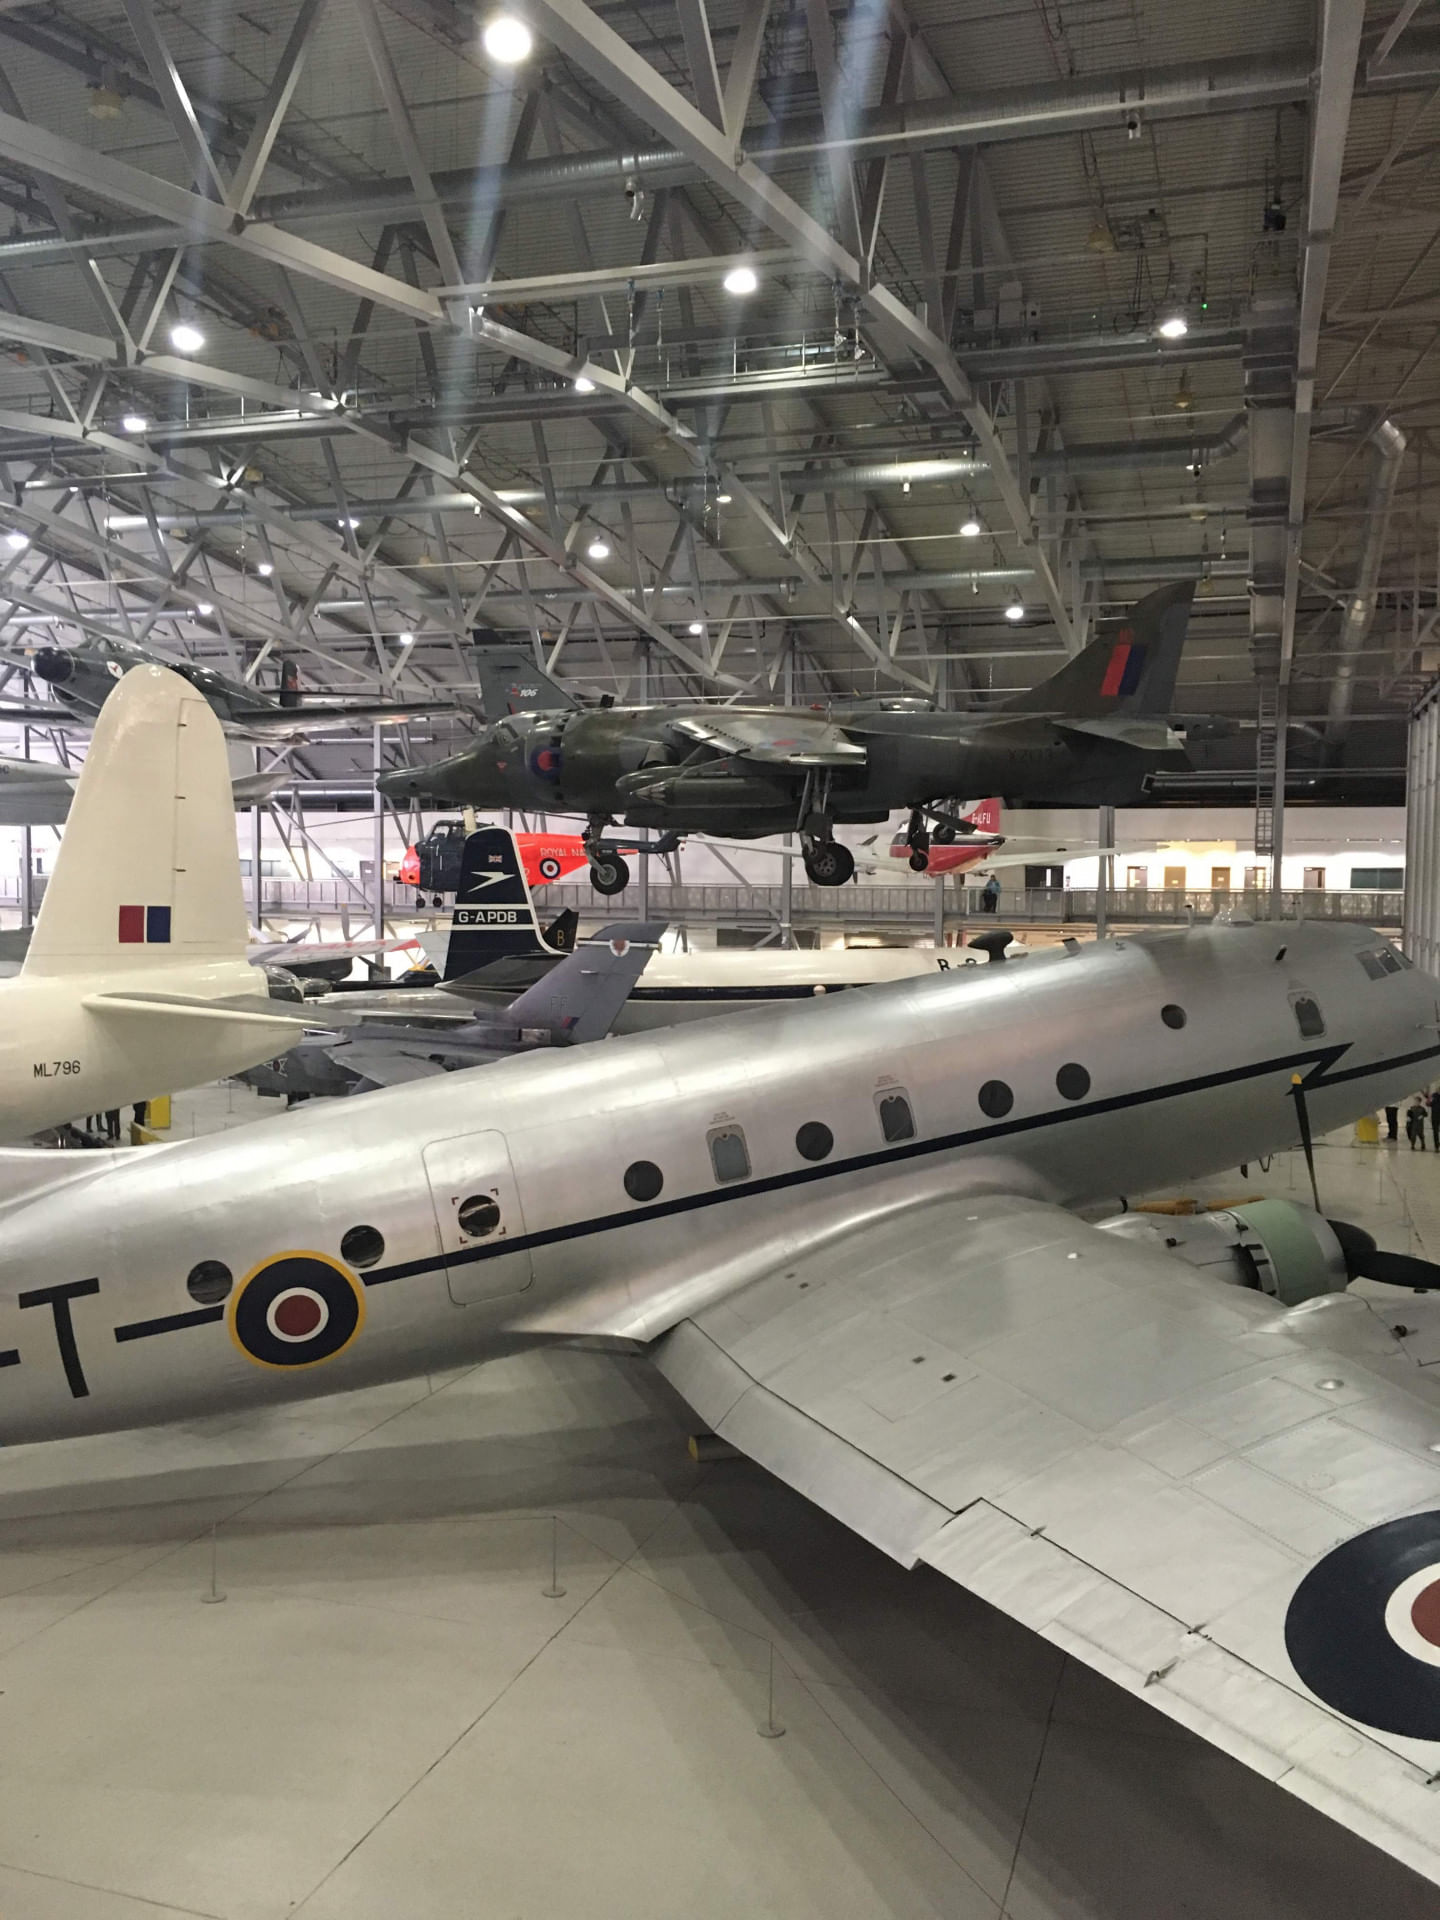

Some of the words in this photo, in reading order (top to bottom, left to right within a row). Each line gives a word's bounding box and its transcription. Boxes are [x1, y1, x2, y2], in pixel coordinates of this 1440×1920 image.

[540, 848, 567, 857] ROYAL
[458, 911, 517, 923] G-APDB
[557, 929, 565, 946] B
[33, 1060, 81, 1079] ML796
